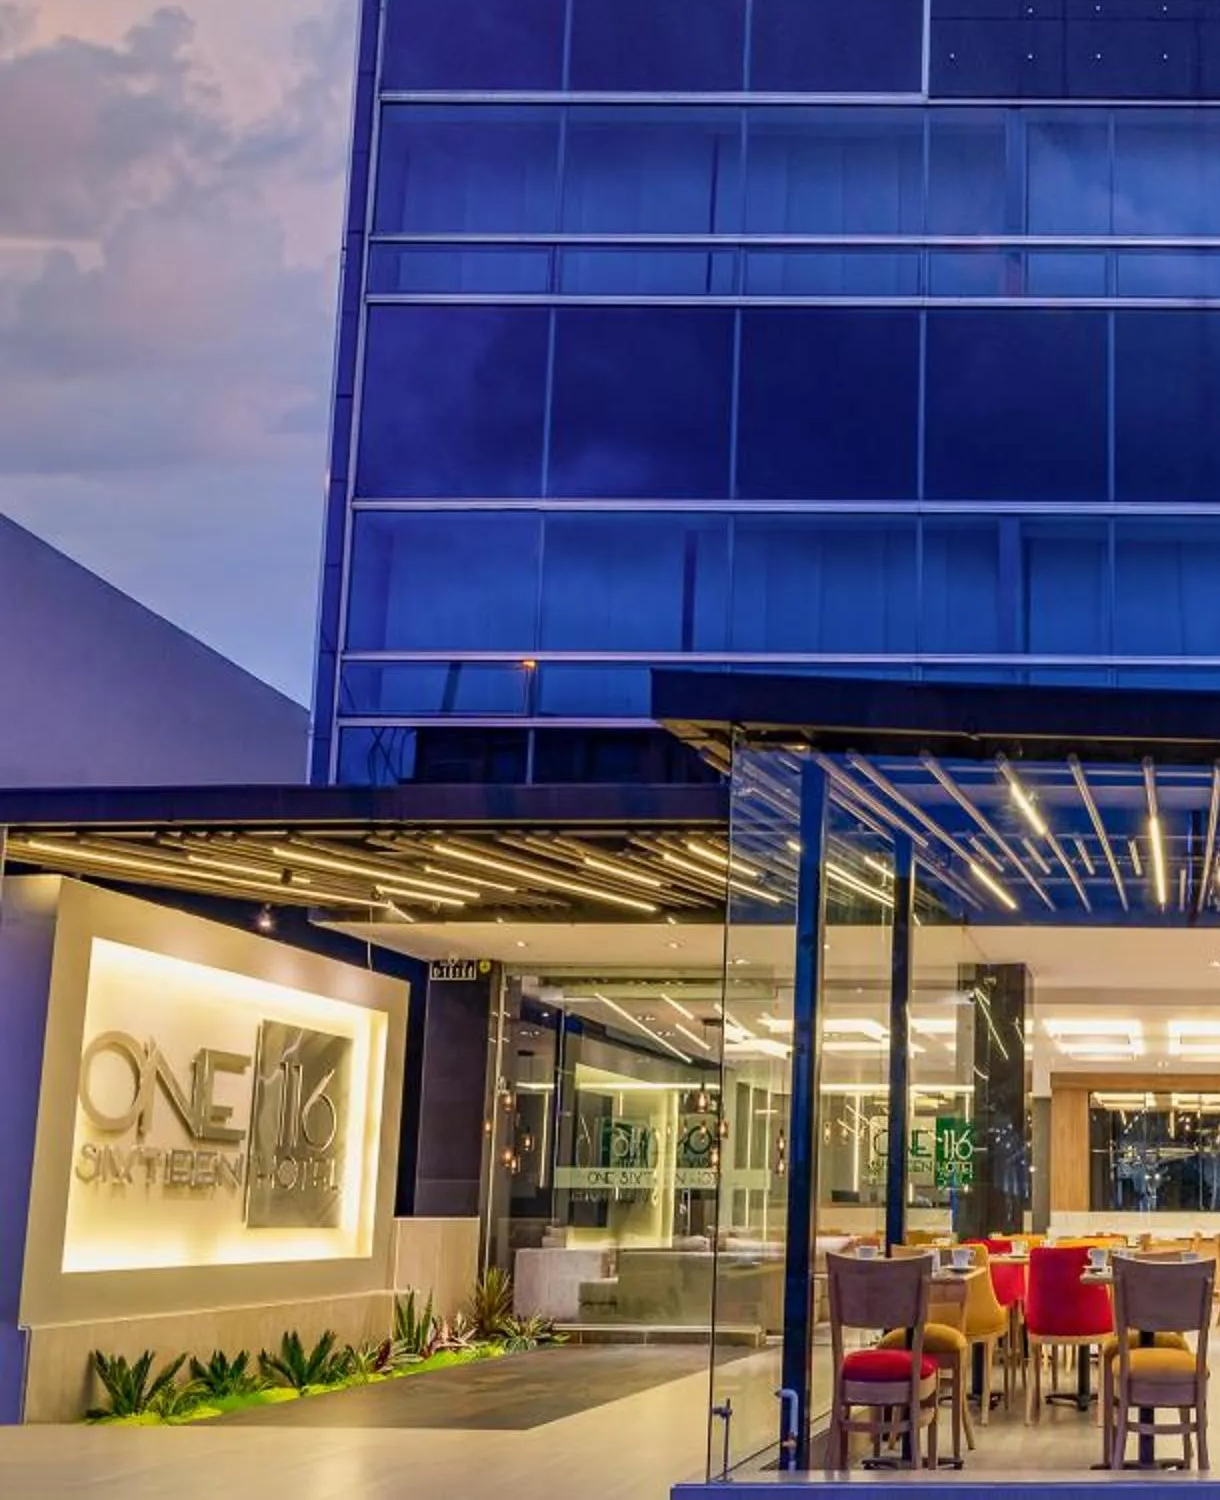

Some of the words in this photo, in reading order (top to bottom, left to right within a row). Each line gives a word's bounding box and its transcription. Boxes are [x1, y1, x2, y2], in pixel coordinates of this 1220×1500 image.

[78, 1030, 251, 1146] ONE
[275, 1061, 337, 1153] 116
[75, 1143, 243, 1190] SIXTEEN
